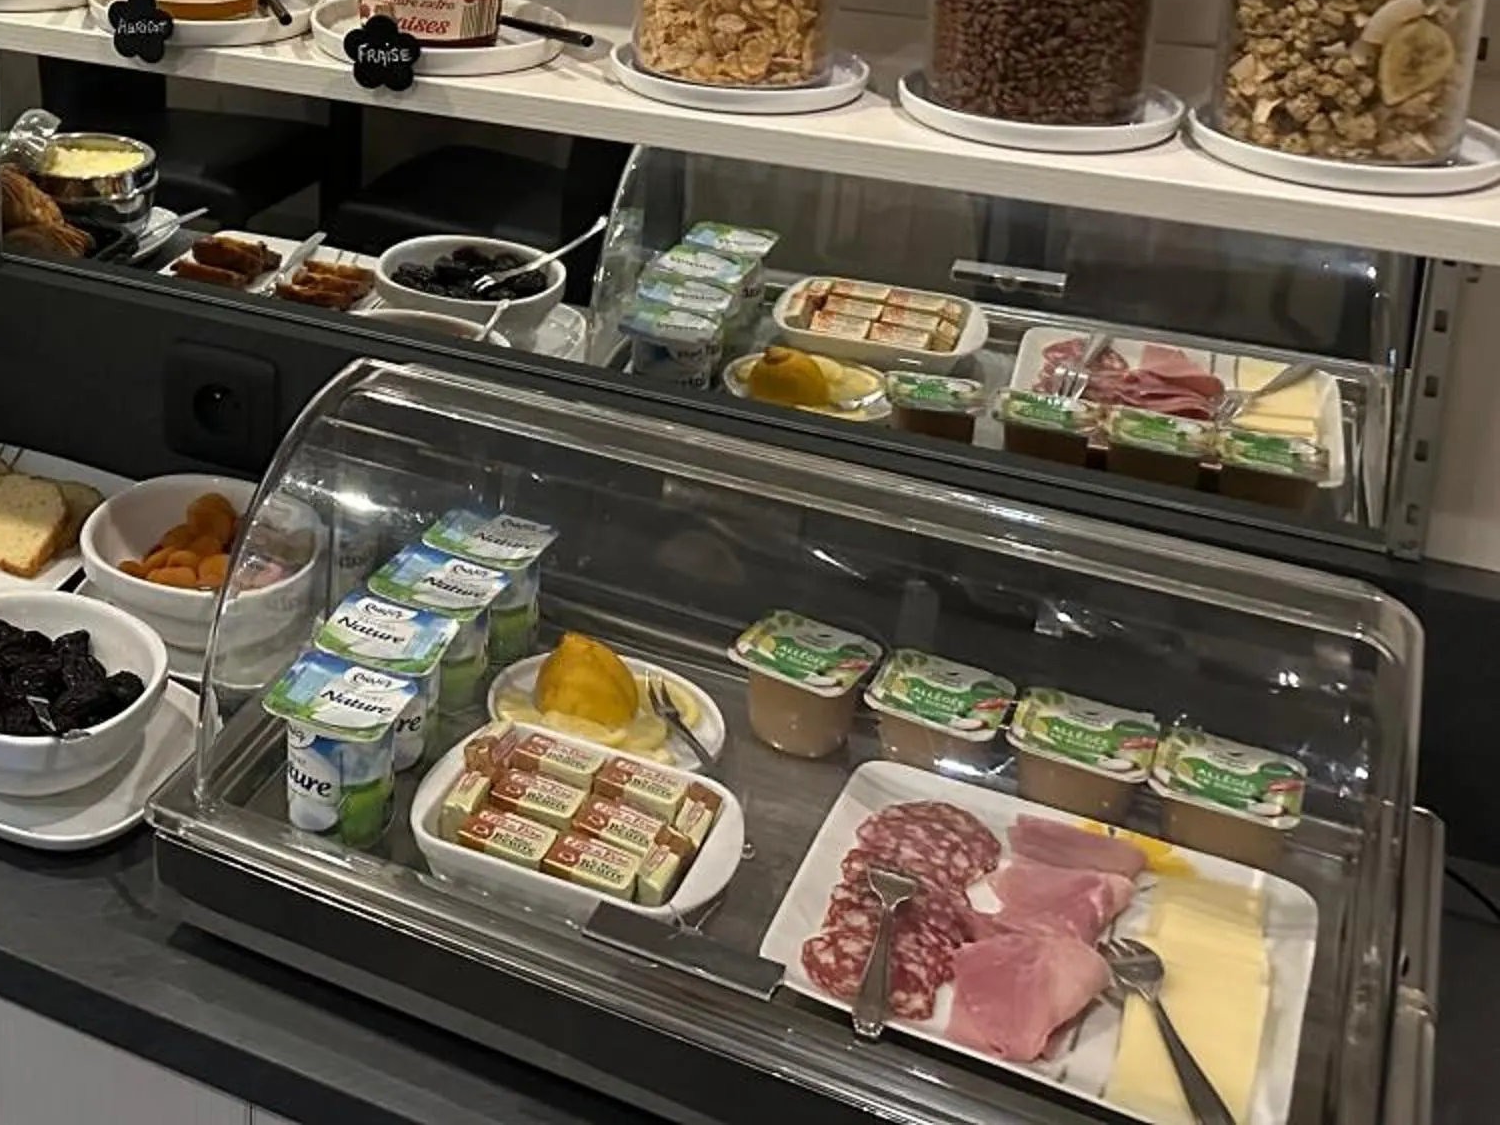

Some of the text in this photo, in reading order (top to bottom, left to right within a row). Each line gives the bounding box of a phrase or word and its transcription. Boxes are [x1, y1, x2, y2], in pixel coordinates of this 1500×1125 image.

[397, 15, 451, 35] aises
[338, 616, 405, 643] Nature
[320, 688, 393, 714] Nature
